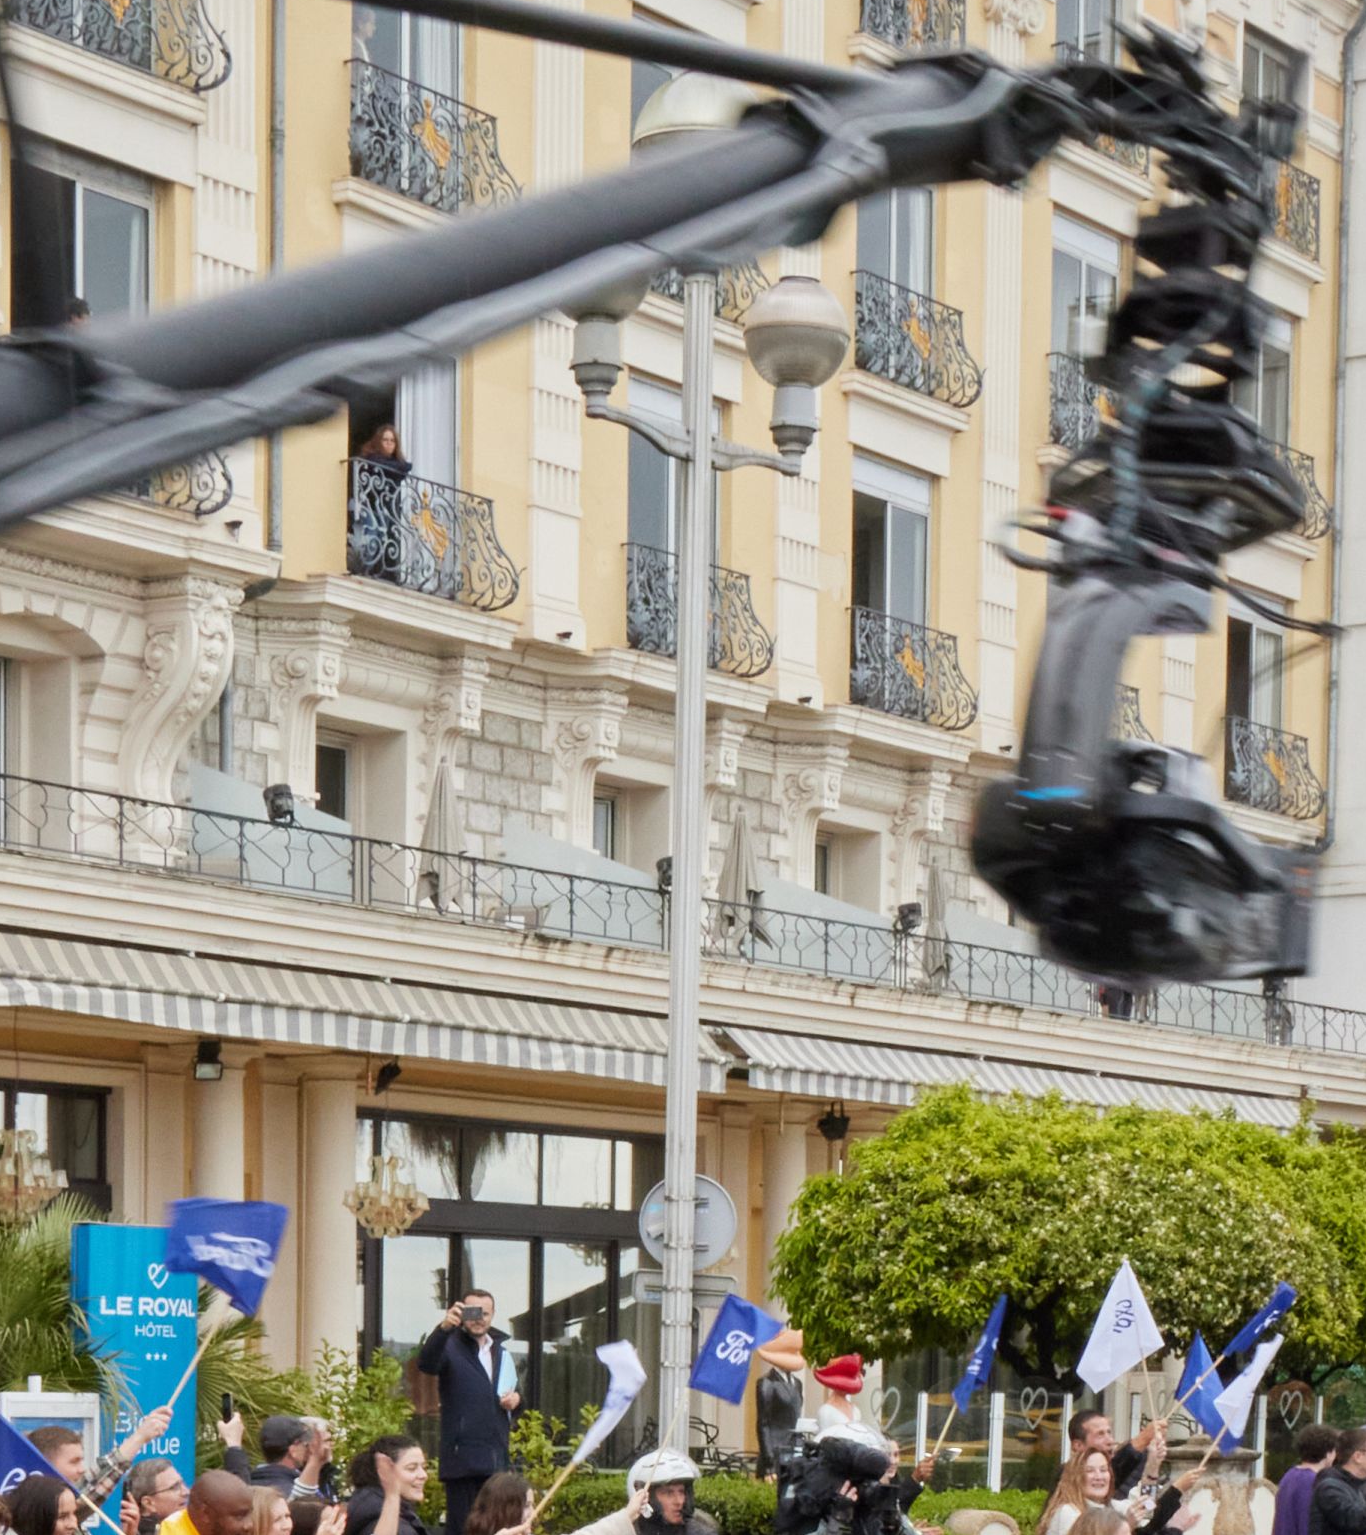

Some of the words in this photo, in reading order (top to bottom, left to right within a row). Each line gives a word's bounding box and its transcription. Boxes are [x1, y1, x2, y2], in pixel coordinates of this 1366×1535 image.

[100, 1296, 133, 1315] LE
[138, 1297, 195, 1317] ROYAL
[135, 1321, 177, 1338] HÔTEL
[716, 1329, 754, 1365] For
